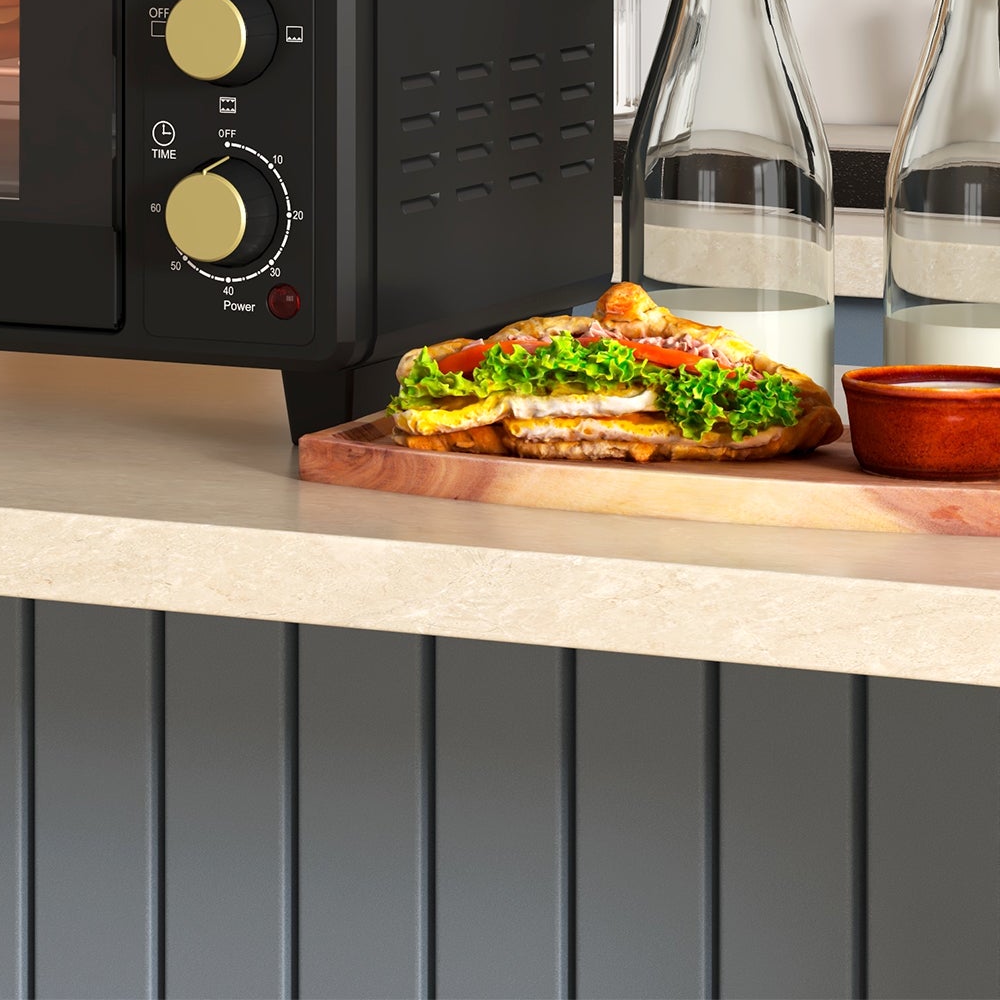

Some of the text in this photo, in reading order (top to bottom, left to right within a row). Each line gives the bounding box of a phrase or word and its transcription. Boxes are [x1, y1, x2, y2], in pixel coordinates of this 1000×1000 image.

[149, 8, 169, 18] OFF
[218, 129, 236, 138] OFF
[152, 149, 176, 159] TIME
[273, 155, 283, 164] 10
[151, 203, 161, 212] 60
[293, 210, 303, 220] 20
[171, 261, 181, 270] 50
[270, 268, 280, 277] 30
[223, 286, 234, 295] 40
[224, 300, 255, 312] Power
